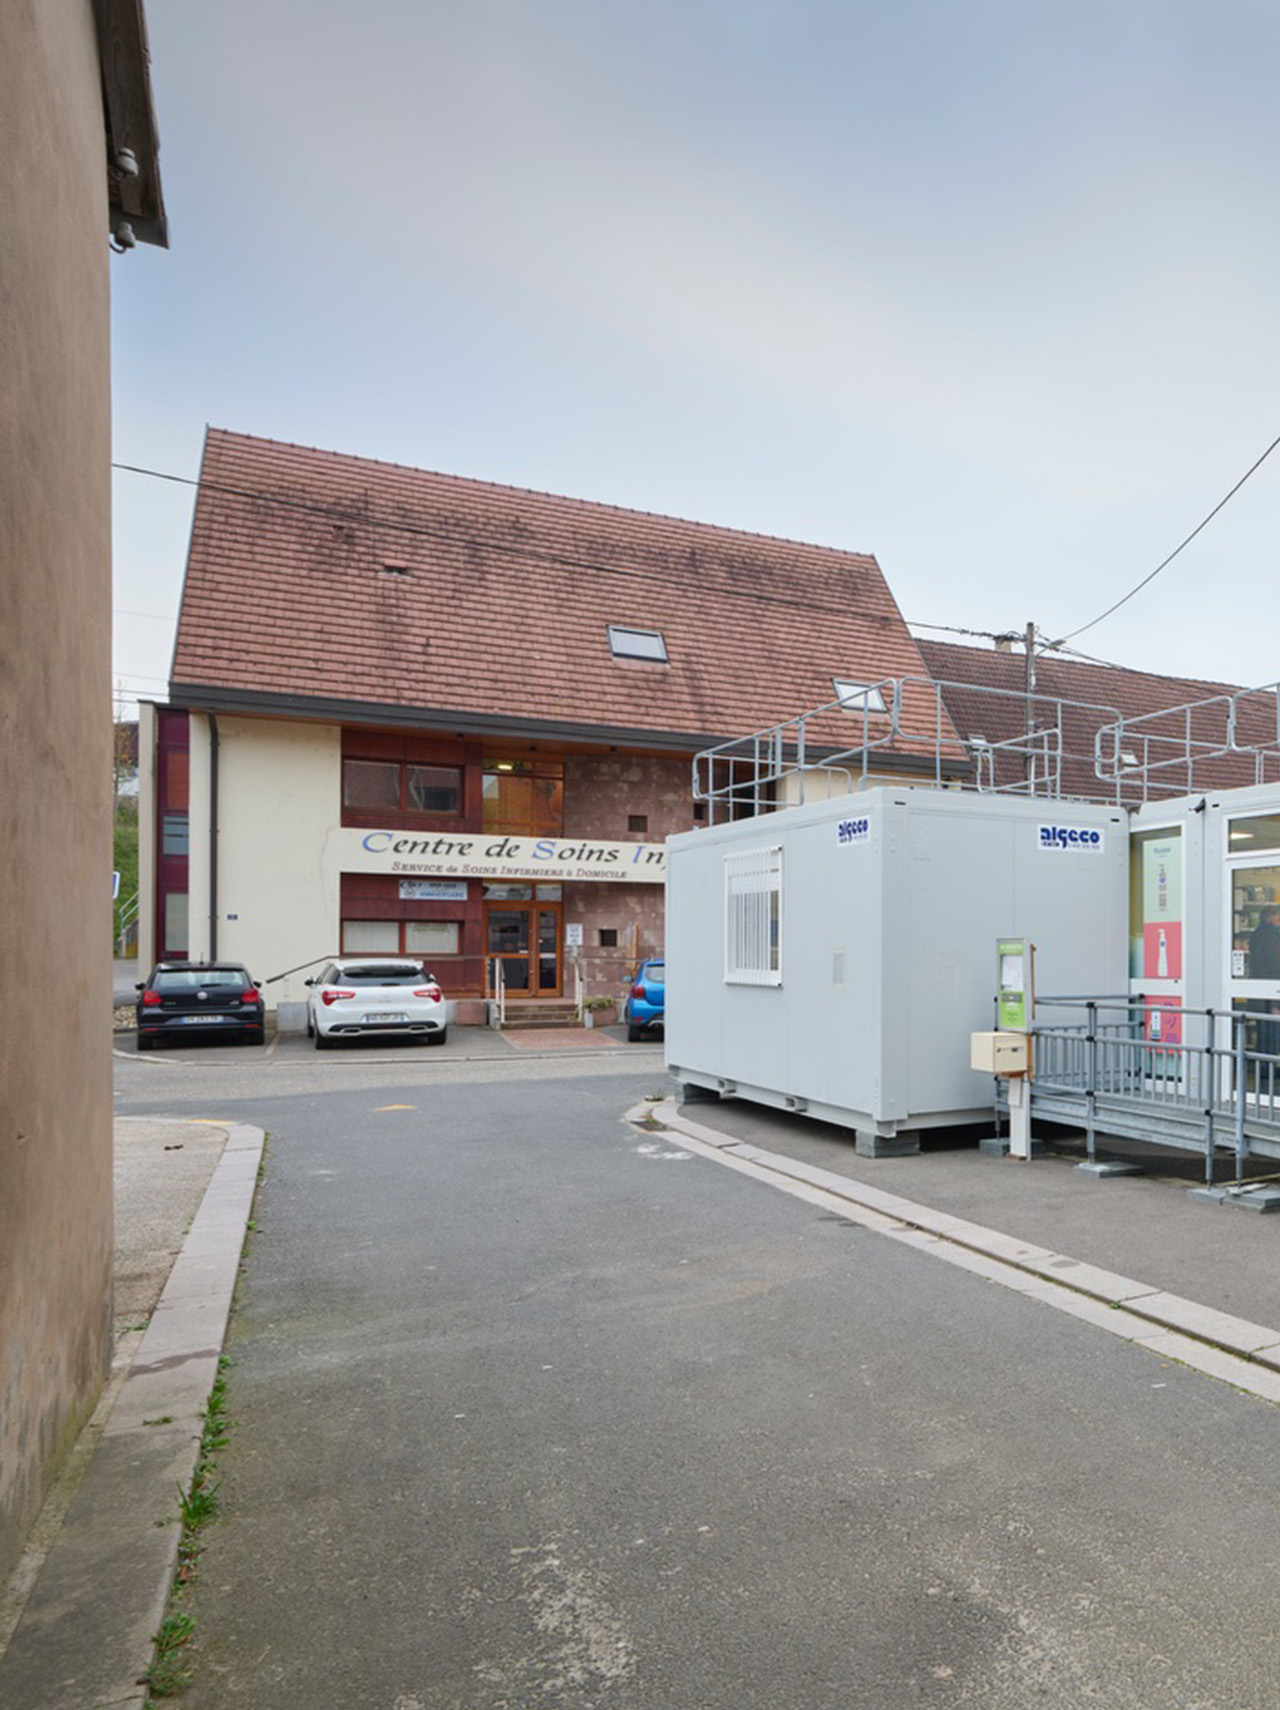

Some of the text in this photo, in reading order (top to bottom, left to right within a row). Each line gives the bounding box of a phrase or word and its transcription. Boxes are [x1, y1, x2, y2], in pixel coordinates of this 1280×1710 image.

[362, 832, 666, 871] Centre de Soins In
[391, 861, 444, 873] SERVICE
[461, 864, 498, 875] SOINS
[500, 865, 564, 877] INFIRMIERS
[576, 868, 628, 879] DOMICILE
